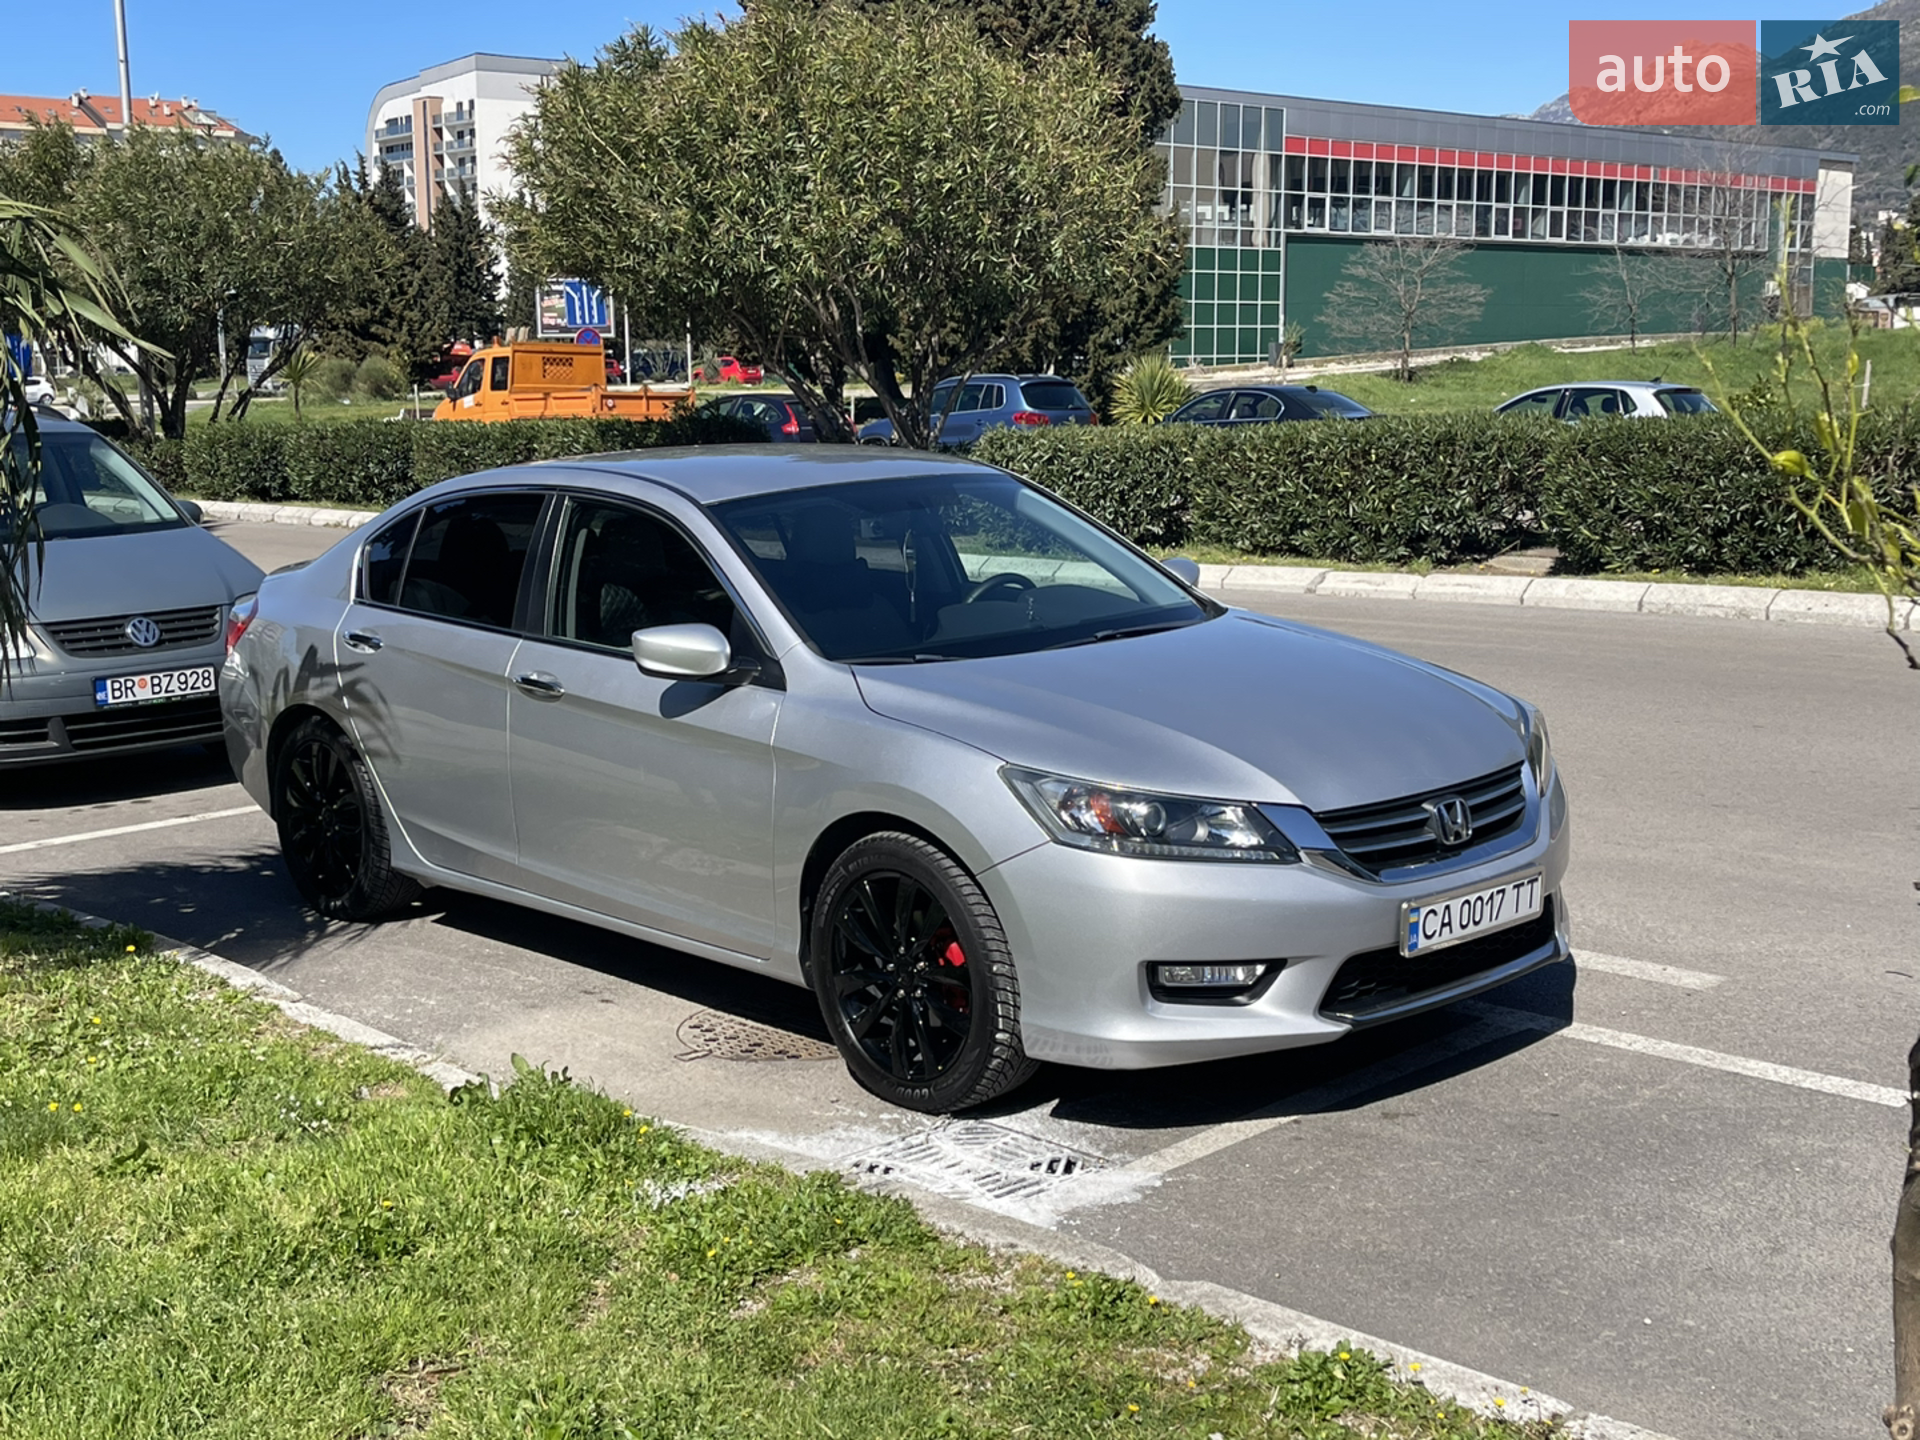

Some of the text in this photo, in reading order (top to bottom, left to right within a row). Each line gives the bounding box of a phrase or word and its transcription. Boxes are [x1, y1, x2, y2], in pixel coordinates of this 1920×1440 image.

[129, 617, 160, 646] VW
[111, 679, 137, 700] BR
[1422, 877, 1538, 940] CA 0017 TT
